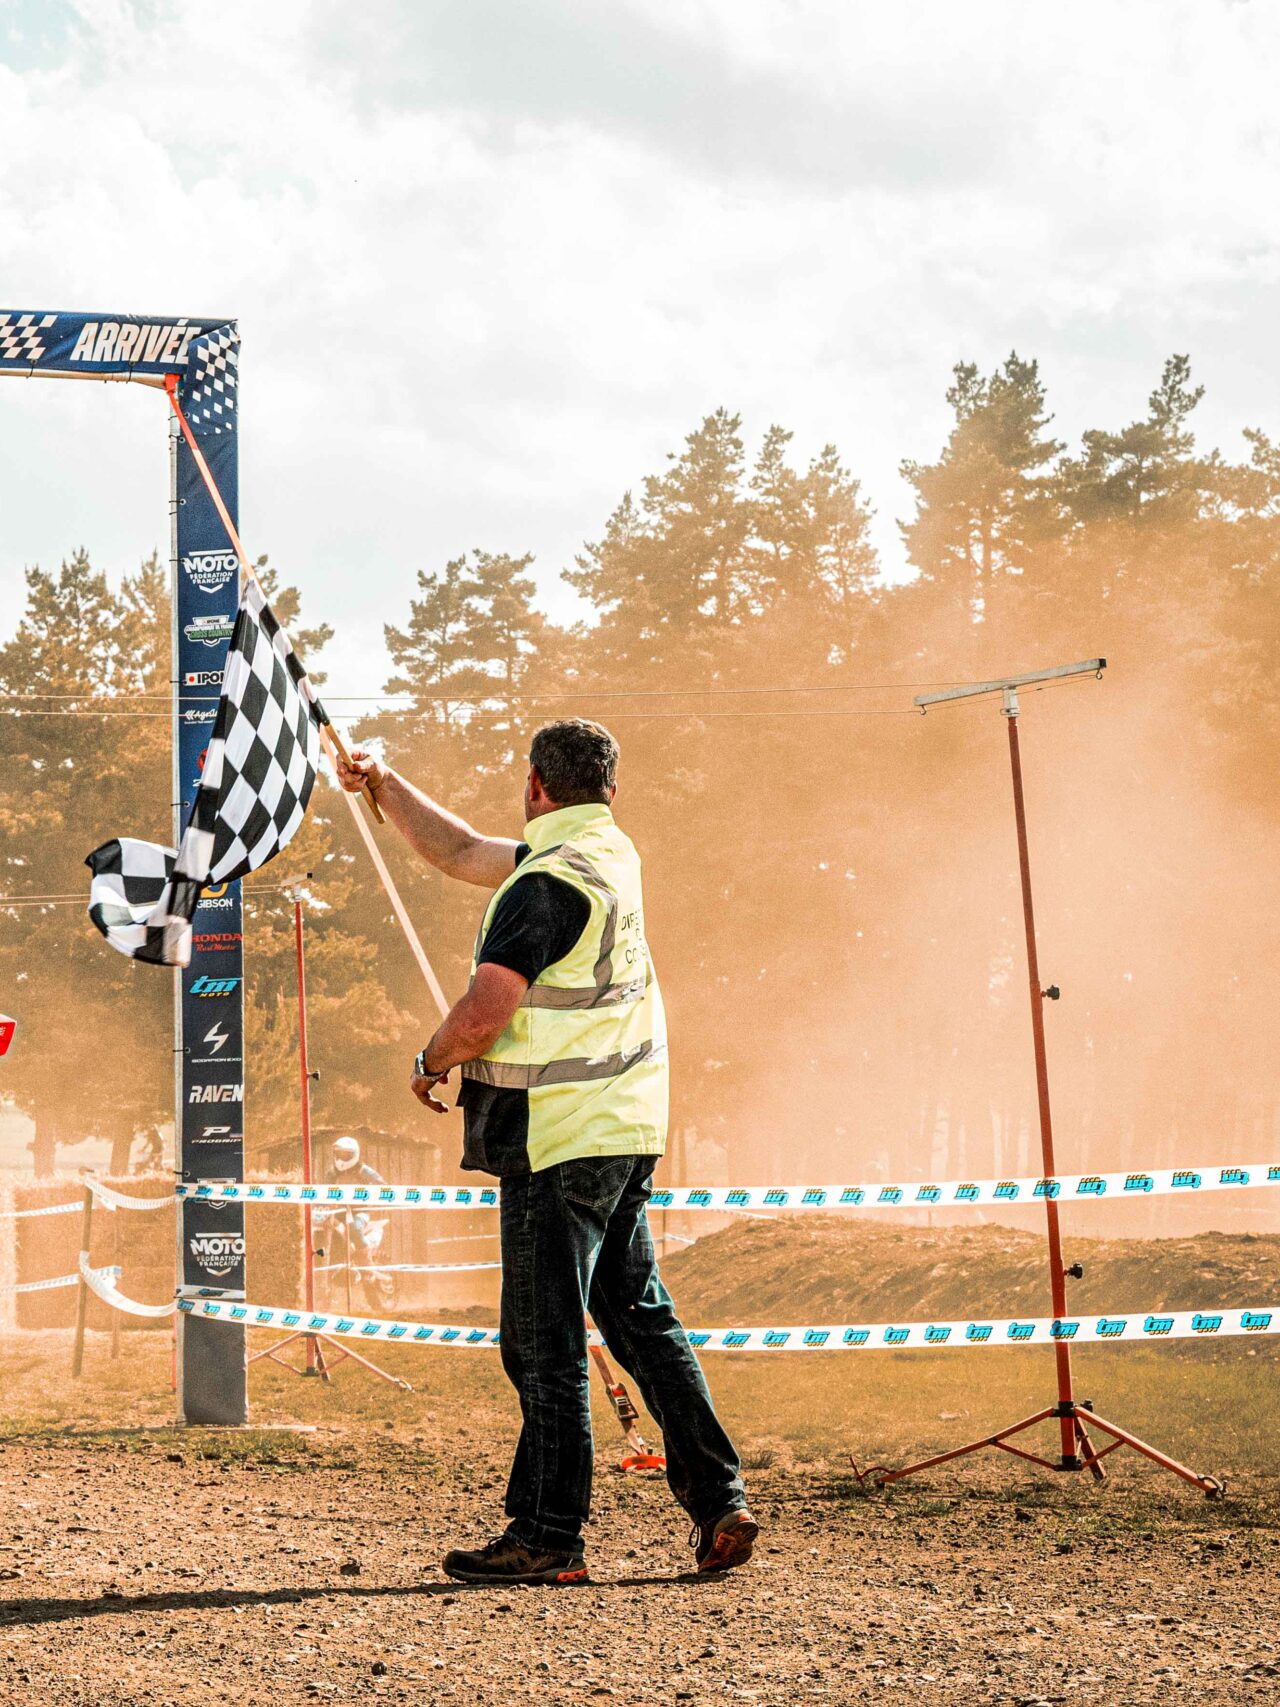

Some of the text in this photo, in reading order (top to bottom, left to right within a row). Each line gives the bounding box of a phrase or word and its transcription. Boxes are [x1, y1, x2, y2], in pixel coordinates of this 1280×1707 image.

[181, 554, 239, 573] MOTO
[190, 571, 233, 580] FÉDÉRATION
[196, 898, 234, 909] GIBSON
[189, 975, 242, 994] tm
[189, 1084, 245, 1104] RAVEN
[190, 1238, 245, 1256] MOTO
[1095, 1318, 1126, 1334] tm
[1142, 1315, 1174, 1332] tm
[1190, 1313, 1223, 1330] tm
[1239, 1311, 1272, 1328] tm
[842, 1327, 870, 1342] tm
[882, 1326, 910, 1341] tm
[923, 1324, 951, 1340] tm
[965, 1323, 992, 1338] tm
[1006, 1321, 1035, 1337] tm
[1048, 1320, 1080, 1336] tm
[721, 1330, 750, 1345] tm
[761, 1330, 789, 1344] tm
[802, 1329, 829, 1344] tm
